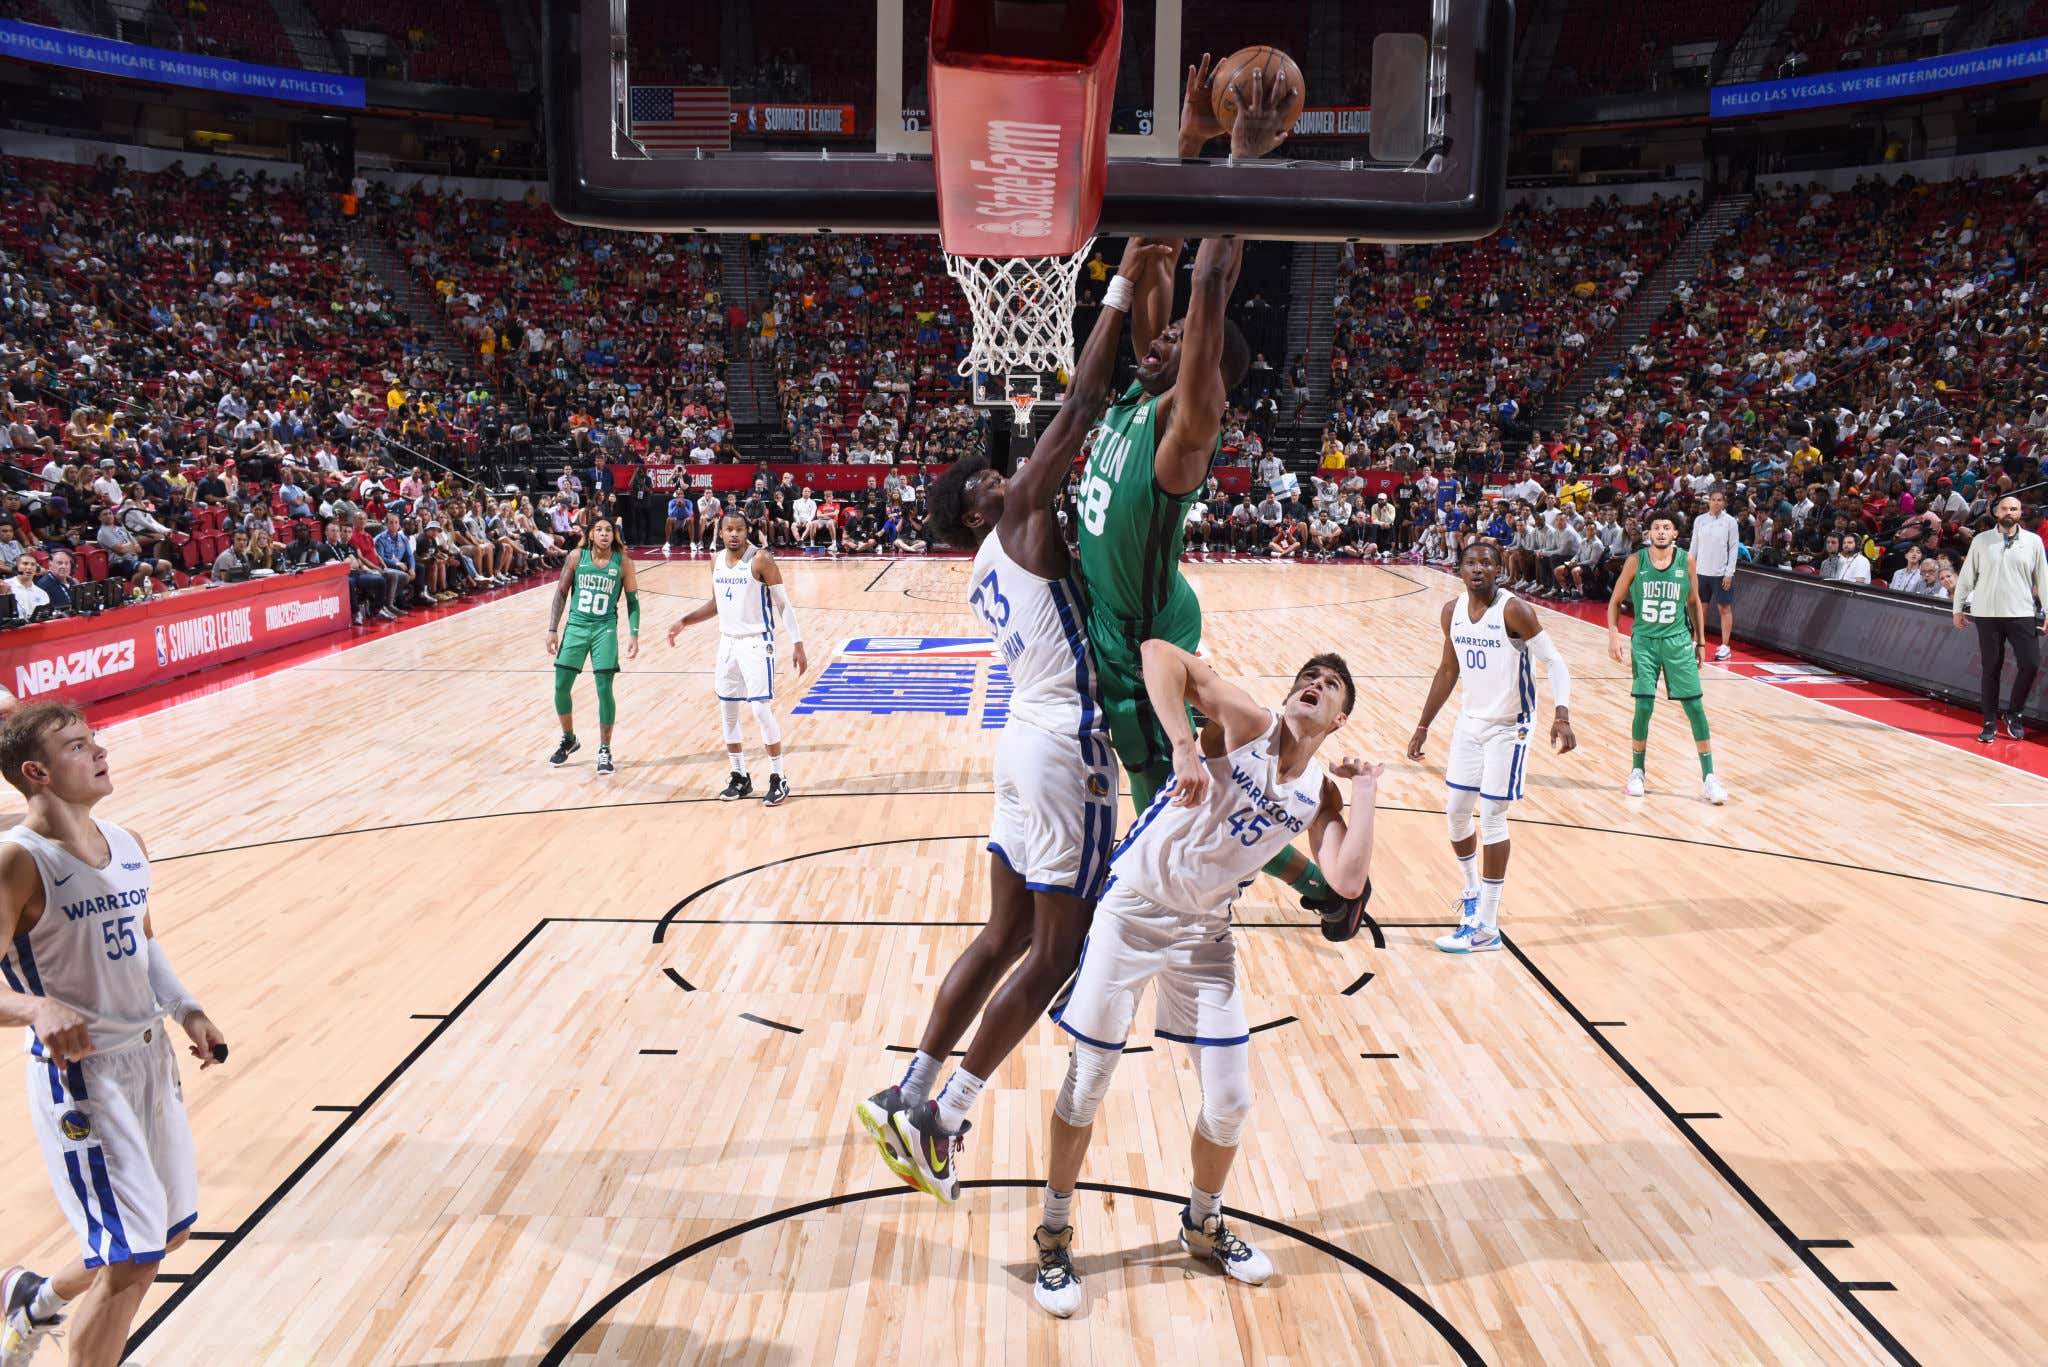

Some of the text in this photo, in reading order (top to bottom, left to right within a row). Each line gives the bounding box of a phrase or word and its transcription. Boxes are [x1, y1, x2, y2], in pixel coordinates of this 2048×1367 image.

[0, 31, 344, 96] OFFICIAL HEALTHCARE PARTNER OF UNLV ATHLETICS
[1721, 91, 1761, 106] HELLO
[1765, 89, 1787, 102] LAS
[1841, 76, 1881, 93] WE'RE
[1886, 56, 2003, 87] INTERMOUNTAIN
[764, 108, 806, 131] SUMMER
[808, 108, 843, 132] LEAGUE
[902, 107, 926, 116] riors
[1138, 119, 1152, 136] 9
[1077, 459, 1112, 536] 28
[578, 574, 616, 594] BOSTON
[725, 586, 733, 601] 4
[1642, 581, 1681, 601] BOSTON
[577, 590, 610, 615] 20
[1641, 599, 1677, 624] 52
[15, 638, 136, 700] NBA2K23
[168, 615, 217, 663] SUMMER
[215, 606, 253, 650] LEAGUE
[1455, 636, 1501, 648] WARRIORS
[1466, 649, 1487, 670] 00
[1231, 765, 1304, 833] WARRIORS
[1227, 806, 1272, 847] 45
[61, 888, 149, 921] WARRIOR
[102, 915, 137, 961] 55
